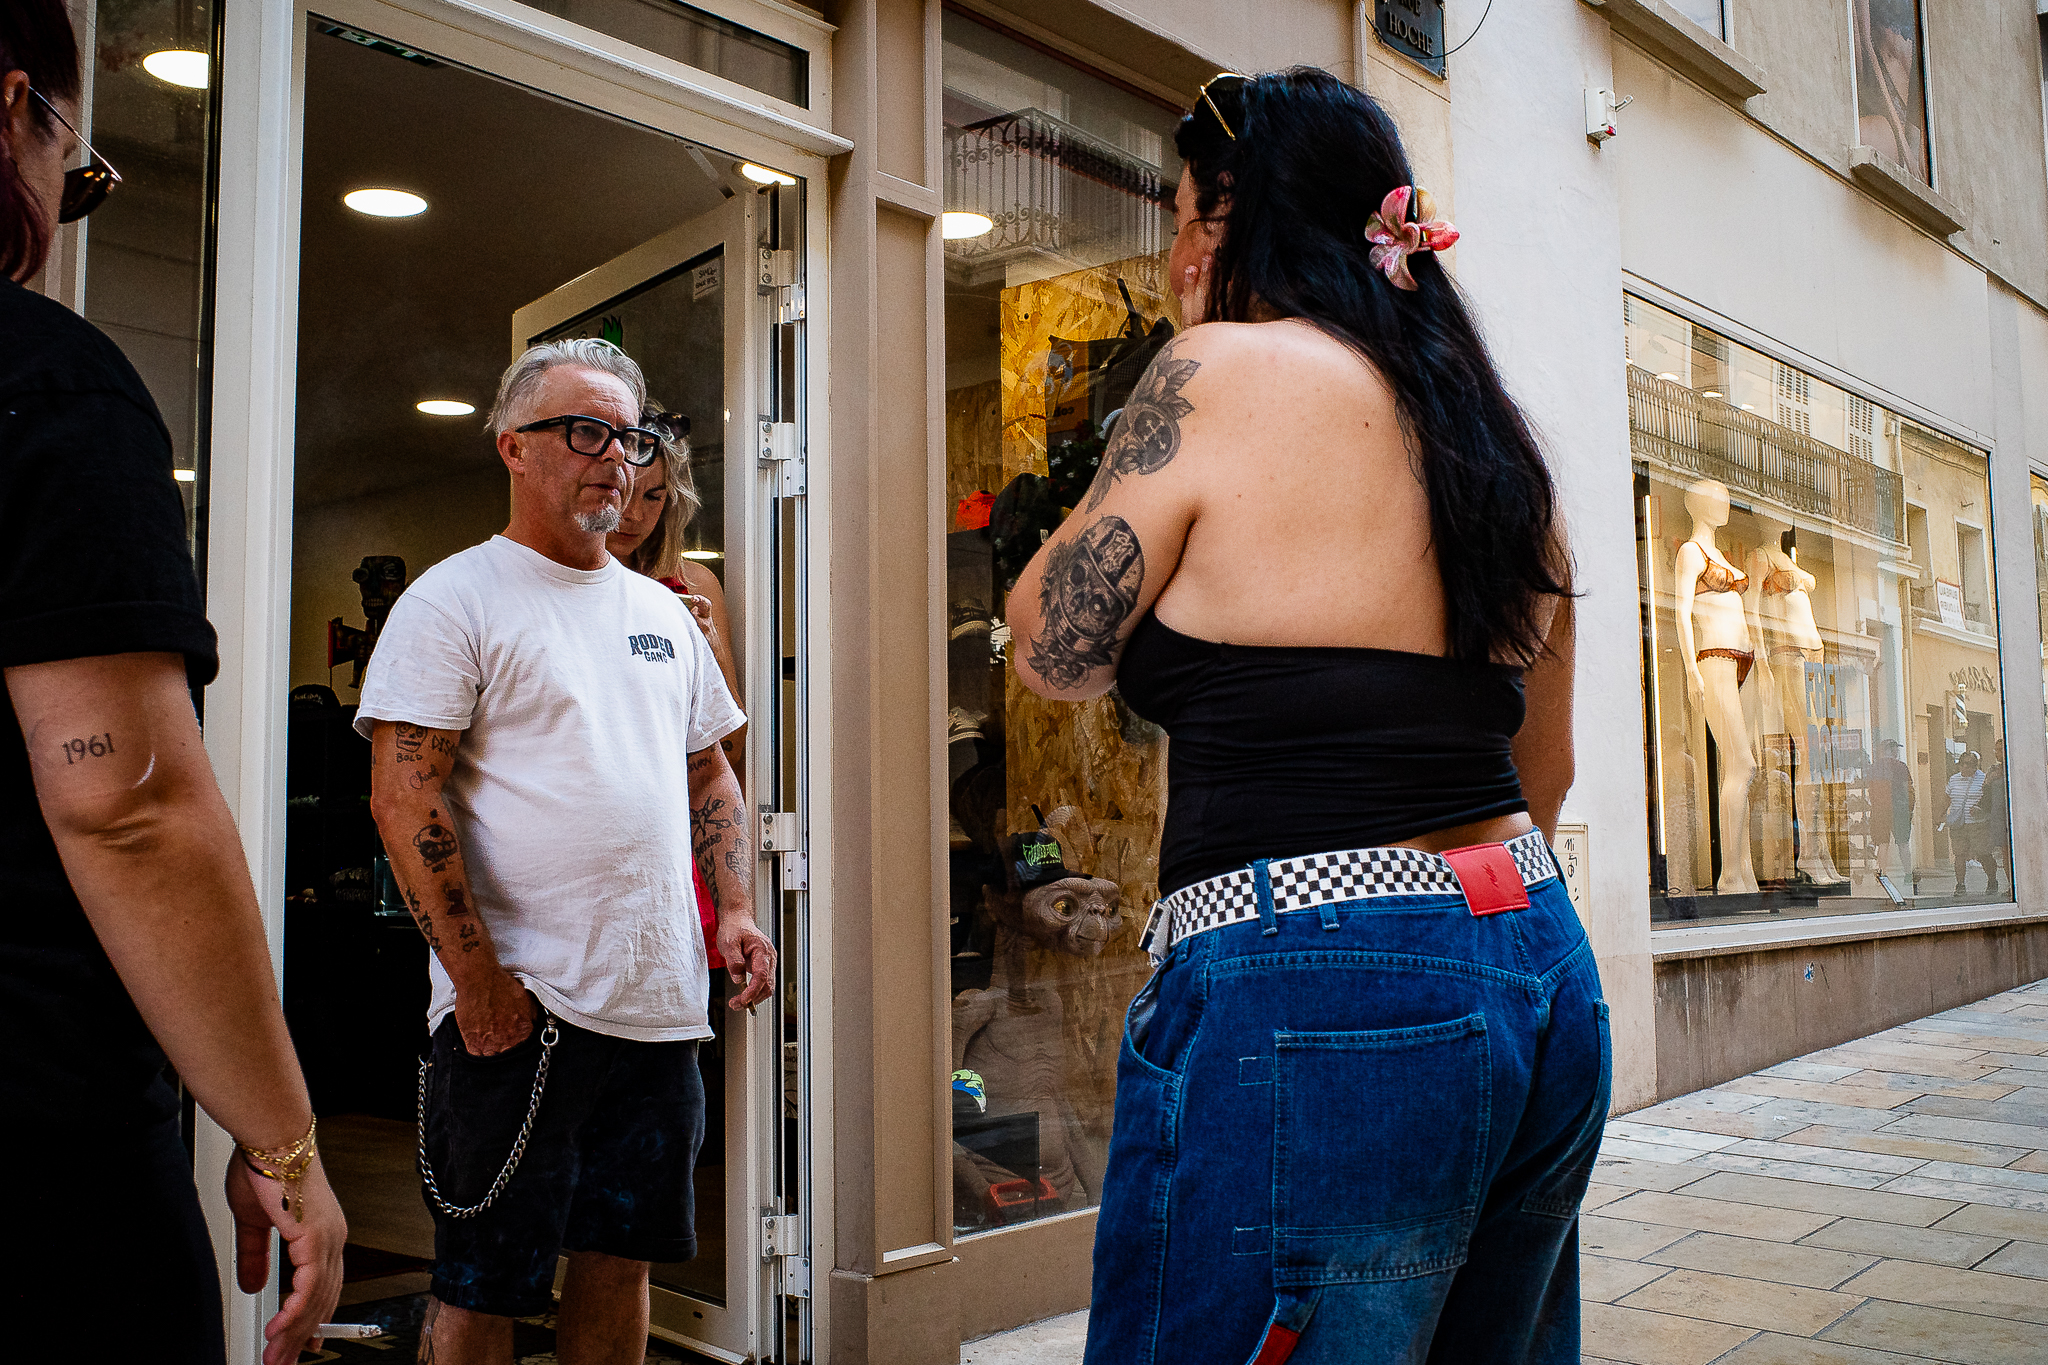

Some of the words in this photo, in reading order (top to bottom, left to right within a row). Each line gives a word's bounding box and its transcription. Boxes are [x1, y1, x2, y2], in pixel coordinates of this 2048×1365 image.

[1387, 11, 1434, 56] HOCHE
[628, 634, 676, 659] RODEO
[643, 651, 668, 664] GANG
[61, 732, 116, 765] 1961
[396, 752, 424, 763] BOLD
